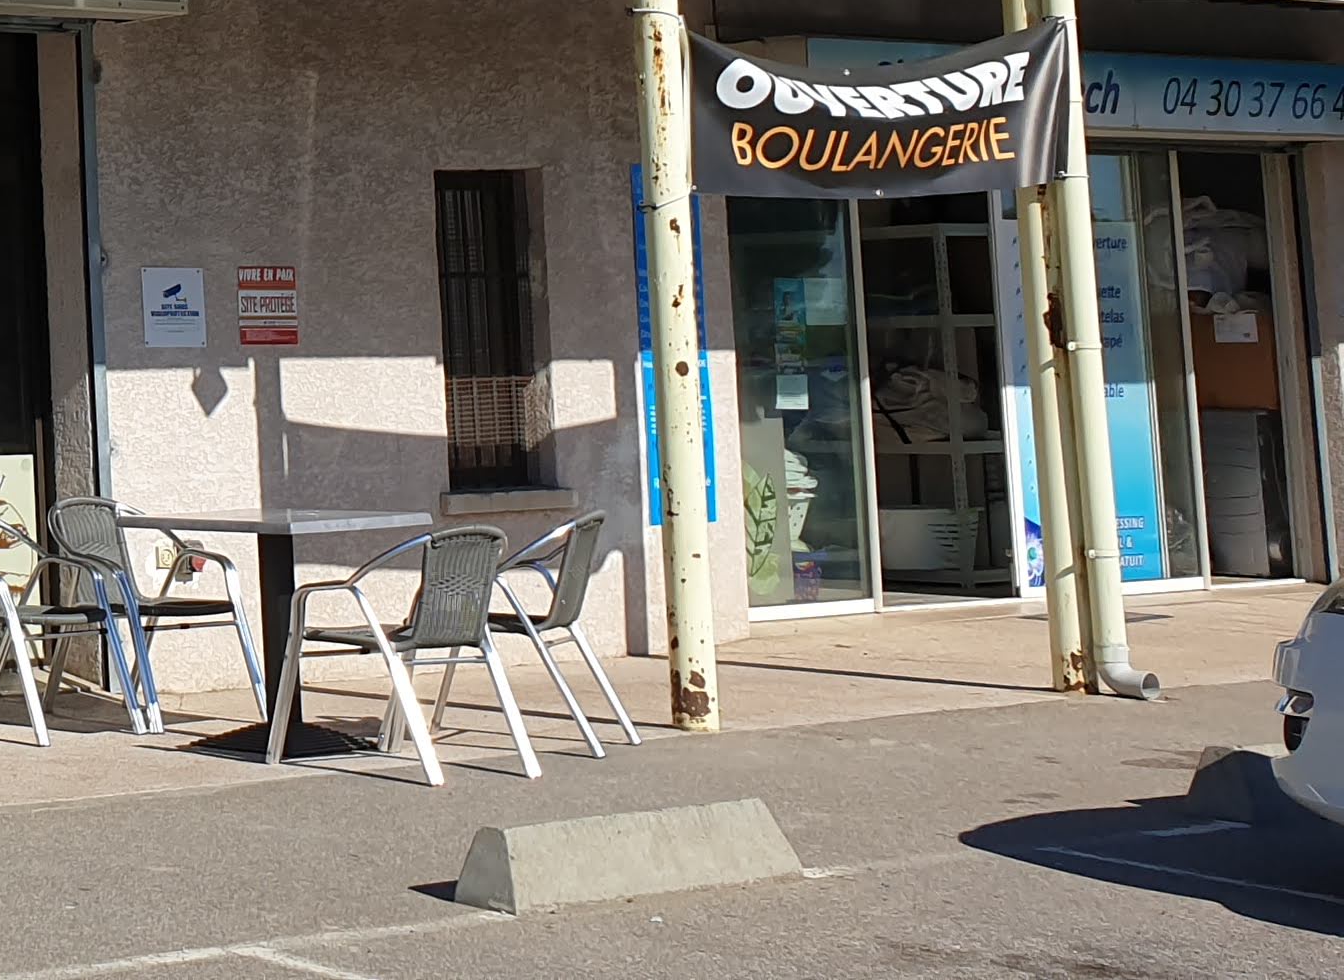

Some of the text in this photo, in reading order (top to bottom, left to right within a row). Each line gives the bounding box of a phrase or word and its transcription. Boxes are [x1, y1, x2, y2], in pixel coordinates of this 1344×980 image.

[716, 51, 1030, 120] OUVERTURE
[1163, 77, 1198, 115] 04
[1206, 80, 1242, 117] 30
[1248, 81, 1286, 118] 37
[1292, 83, 1326, 120] 66
[731, 116, 1015, 172] BOULANGERIE
[1096, 236, 1128, 250] erture
[240, 296, 258, 313] SITE
